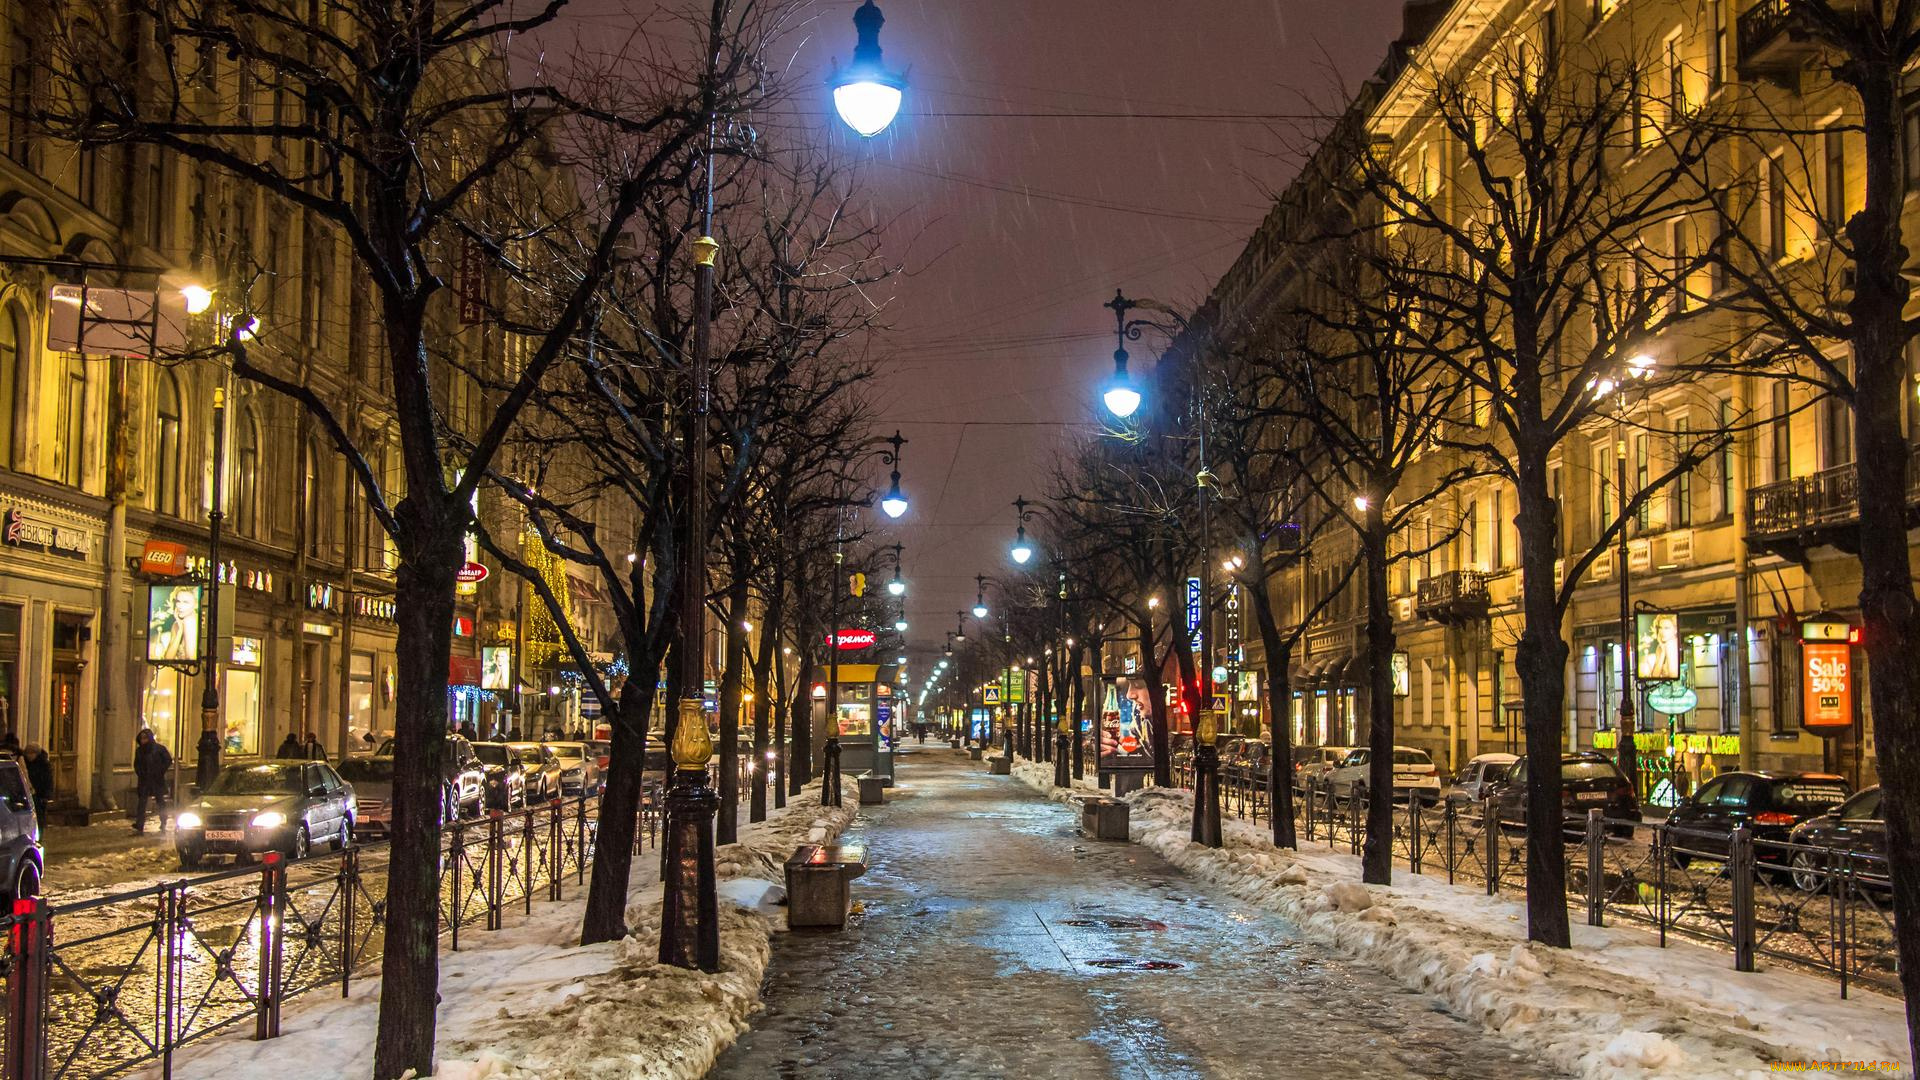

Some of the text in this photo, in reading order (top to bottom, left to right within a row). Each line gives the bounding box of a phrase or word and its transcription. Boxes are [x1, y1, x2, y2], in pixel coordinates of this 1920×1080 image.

[146, 551, 173, 564] LEGO
[827, 634, 875, 646] Тремок
[1808, 656, 1847, 677] Sale
[1811, 677, 1846, 693] 50%
